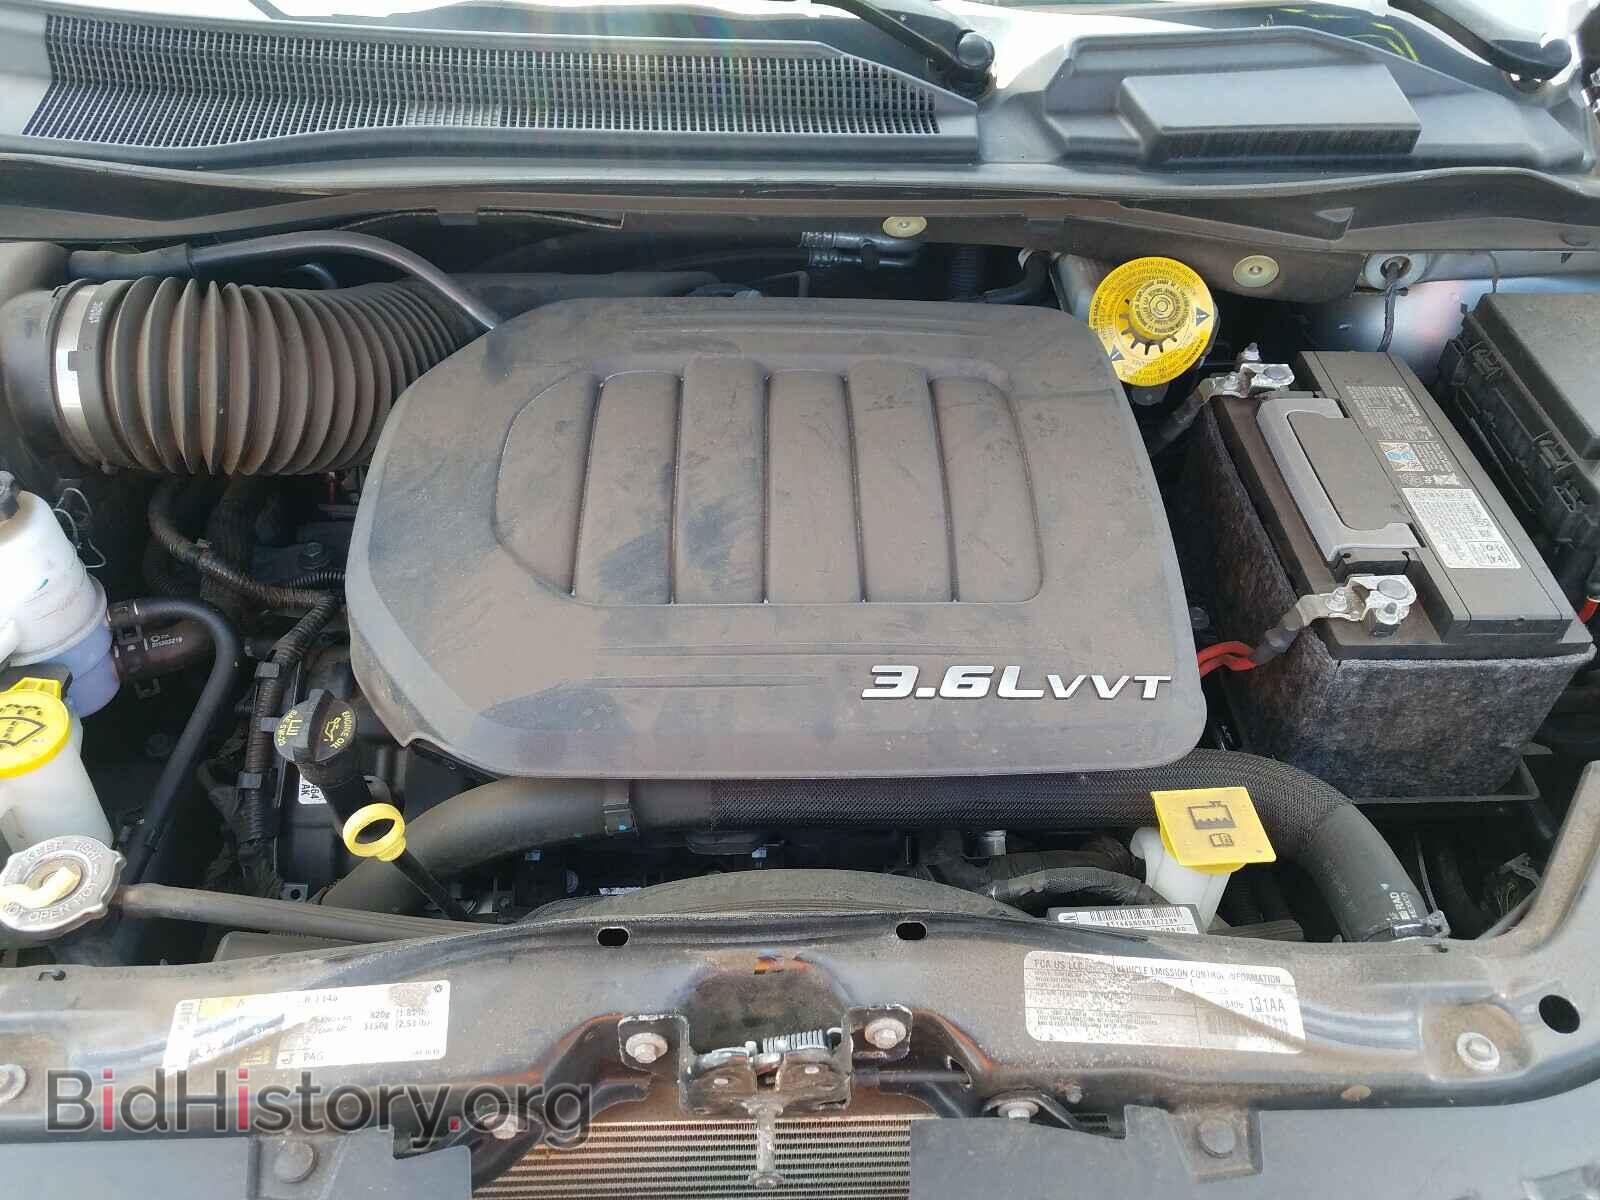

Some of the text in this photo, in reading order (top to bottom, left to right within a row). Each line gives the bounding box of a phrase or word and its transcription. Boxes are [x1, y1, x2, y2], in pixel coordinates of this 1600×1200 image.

[330, 737, 345, 749] OIL
[301, 784, 311, 796] AK
[28, 900, 72, 921] OPEN
[73, 881, 98, 906] HOT
[1054, 960, 1066, 969] US
[1151, 967, 1188, 977] EMISSION
